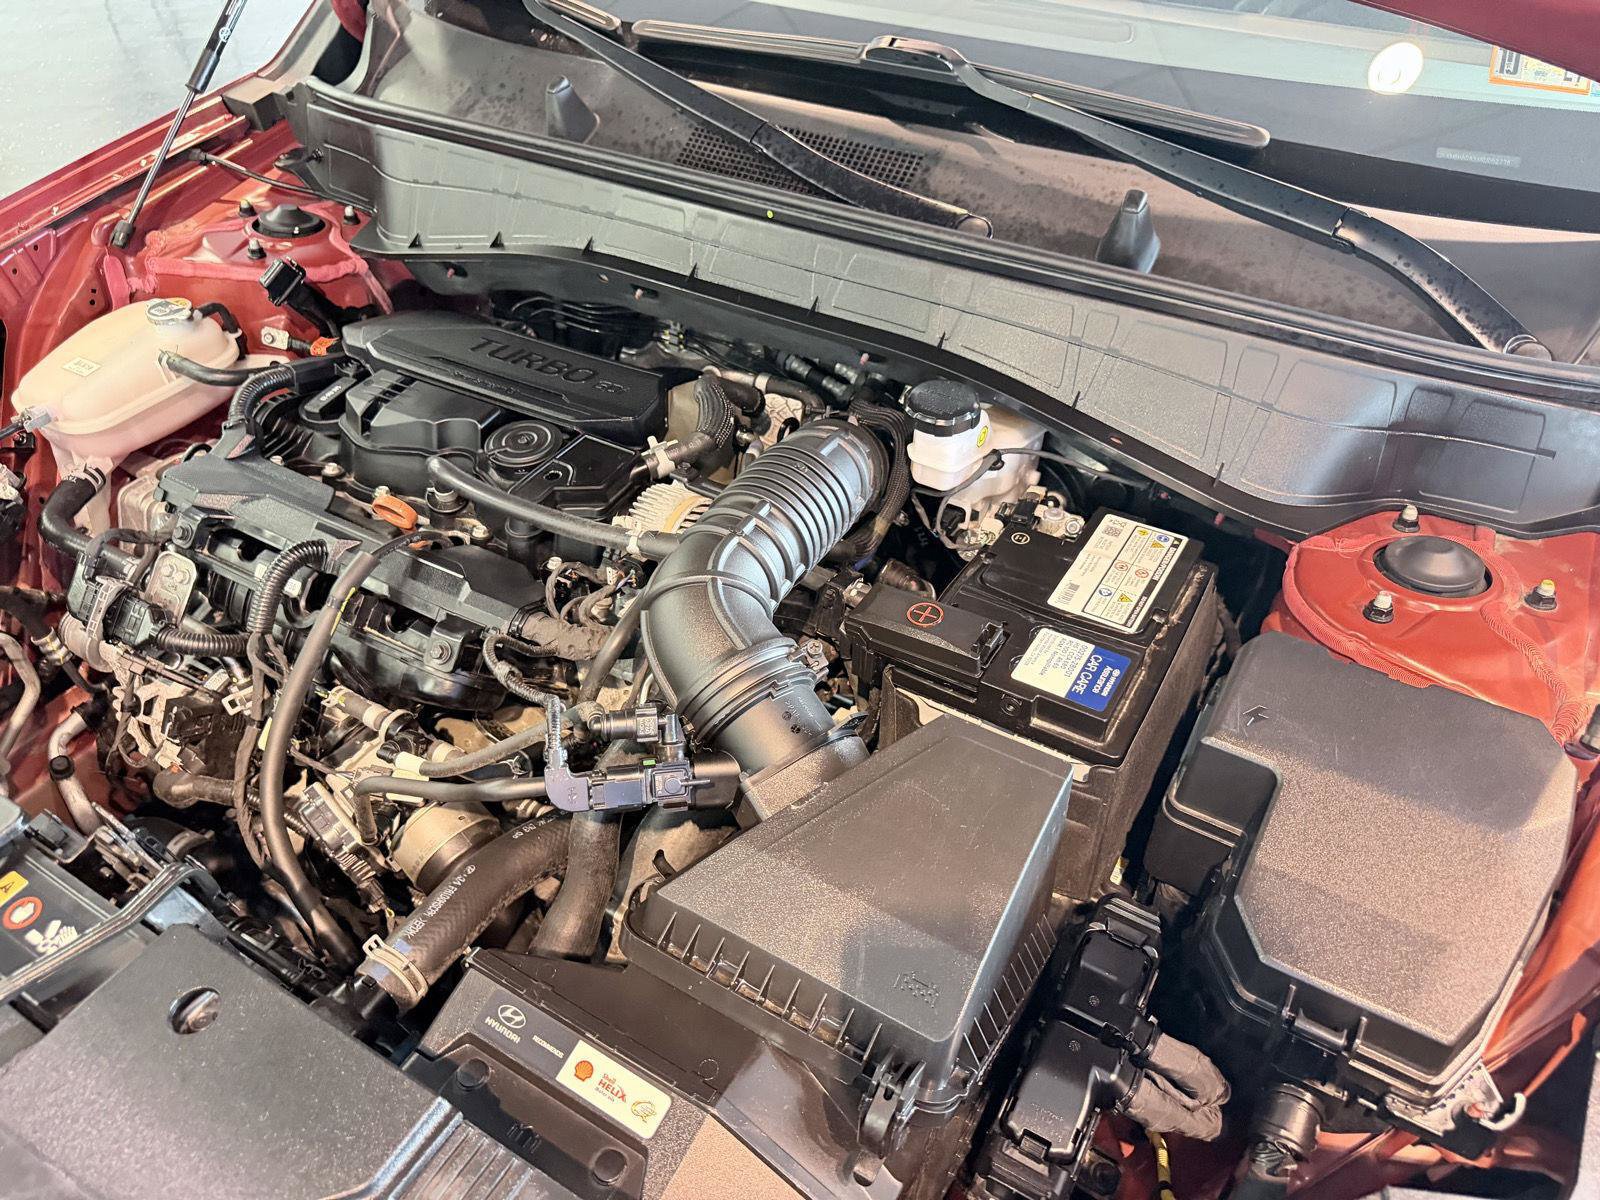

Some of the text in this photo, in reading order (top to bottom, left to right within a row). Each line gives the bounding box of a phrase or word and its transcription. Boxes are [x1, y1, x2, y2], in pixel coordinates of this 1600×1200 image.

[470, 337, 597, 383] TURBO
[1071, 654, 1103, 695] CAR CARE
[1092, 665, 1113, 694] Assurance
[484, 1016, 521, 1044] HYUNDAI
[532, 1034, 565, 1059] RECOMMENDS
[598, 1079, 627, 1103] HELIX
